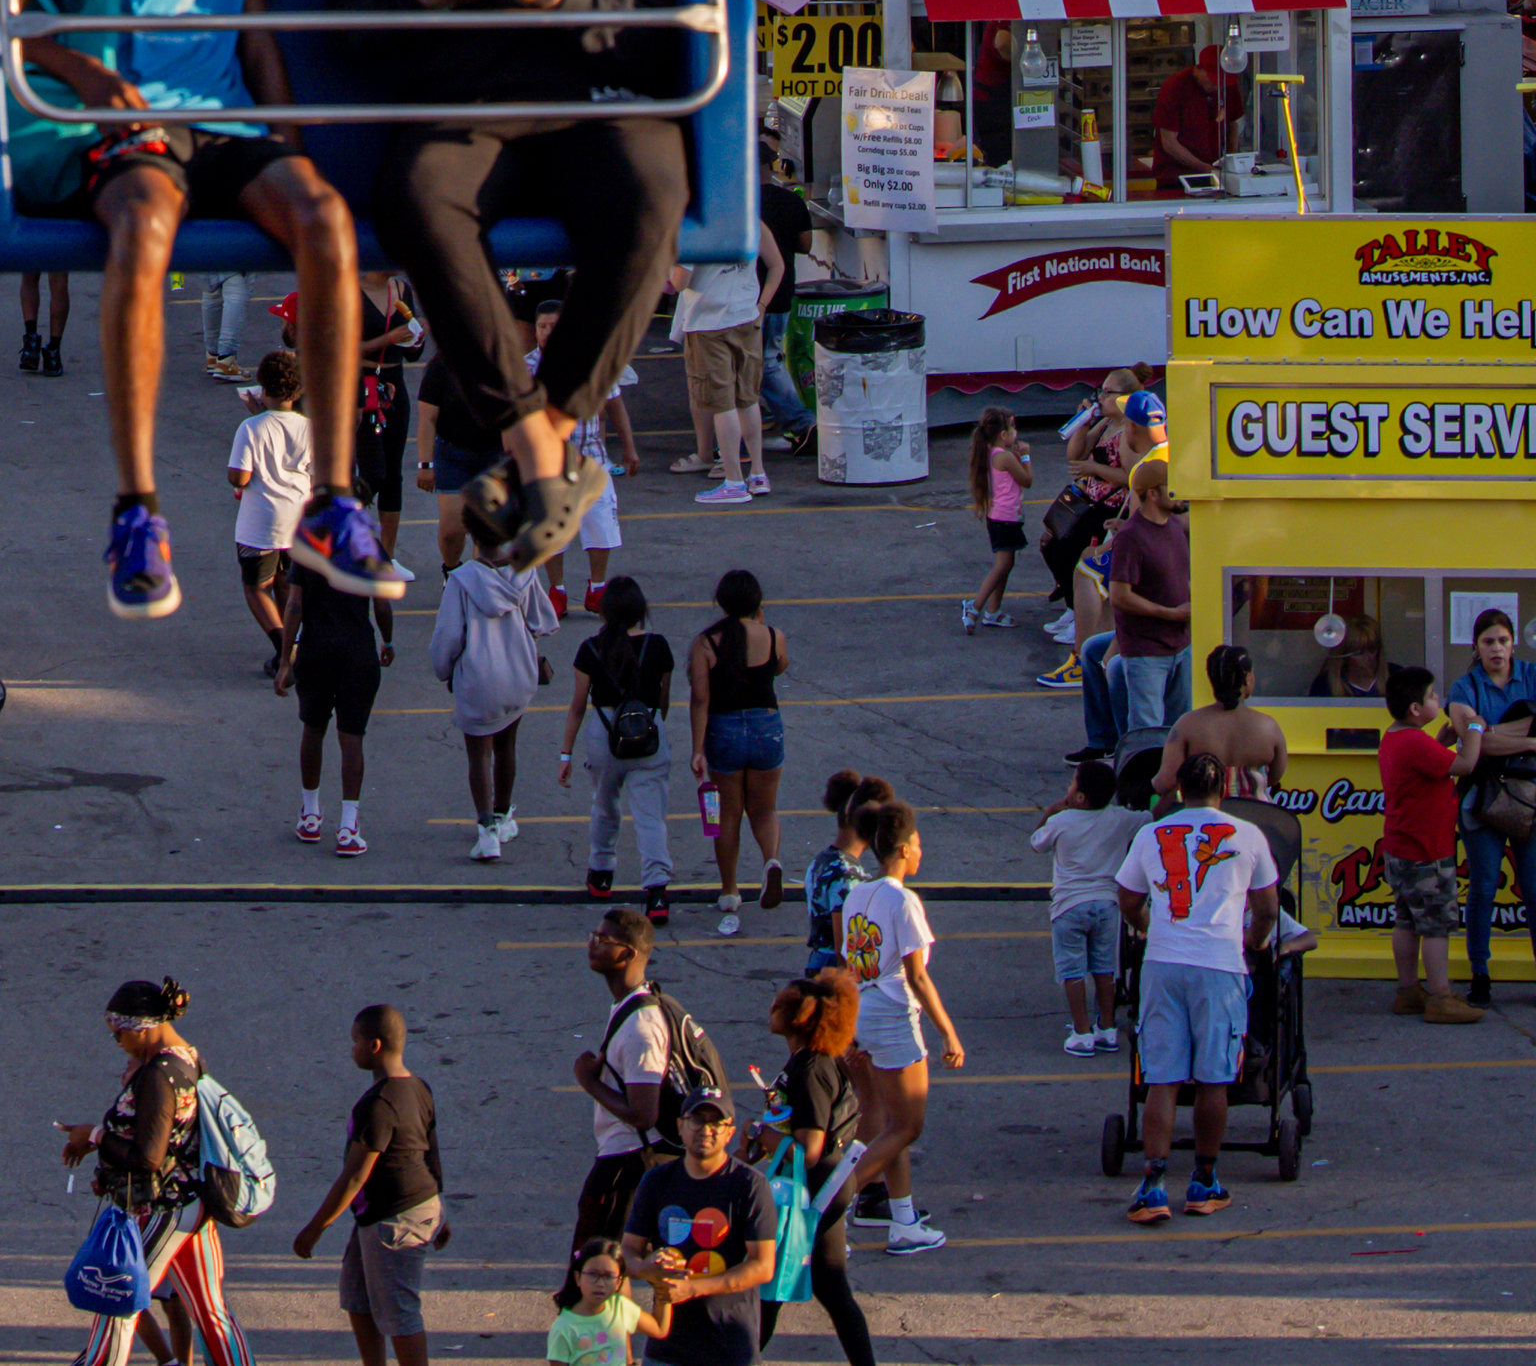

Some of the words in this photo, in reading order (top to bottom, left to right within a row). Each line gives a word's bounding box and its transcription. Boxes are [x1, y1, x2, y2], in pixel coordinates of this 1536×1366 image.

[777, 22, 882, 74] $2.00
[781, 80, 819, 96] HOT
[848, 86, 867, 98] Fair
[870, 87, 897, 100] Drink
[901, 89, 928, 102] Deals
[863, 179, 885, 192] Only
[887, 180, 913, 191] $2.00
[1355, 228, 1498, 270] TALLEY
[1007, 267, 1041, 296] First
[1044, 254, 1115, 278] National
[1119, 253, 1163, 274] Bank
[1188, 298, 1281, 338] How
[1292, 298, 1374, 339] Can
[1382, 299, 1450, 339] We
[1229, 401, 1389, 457] GUEST
